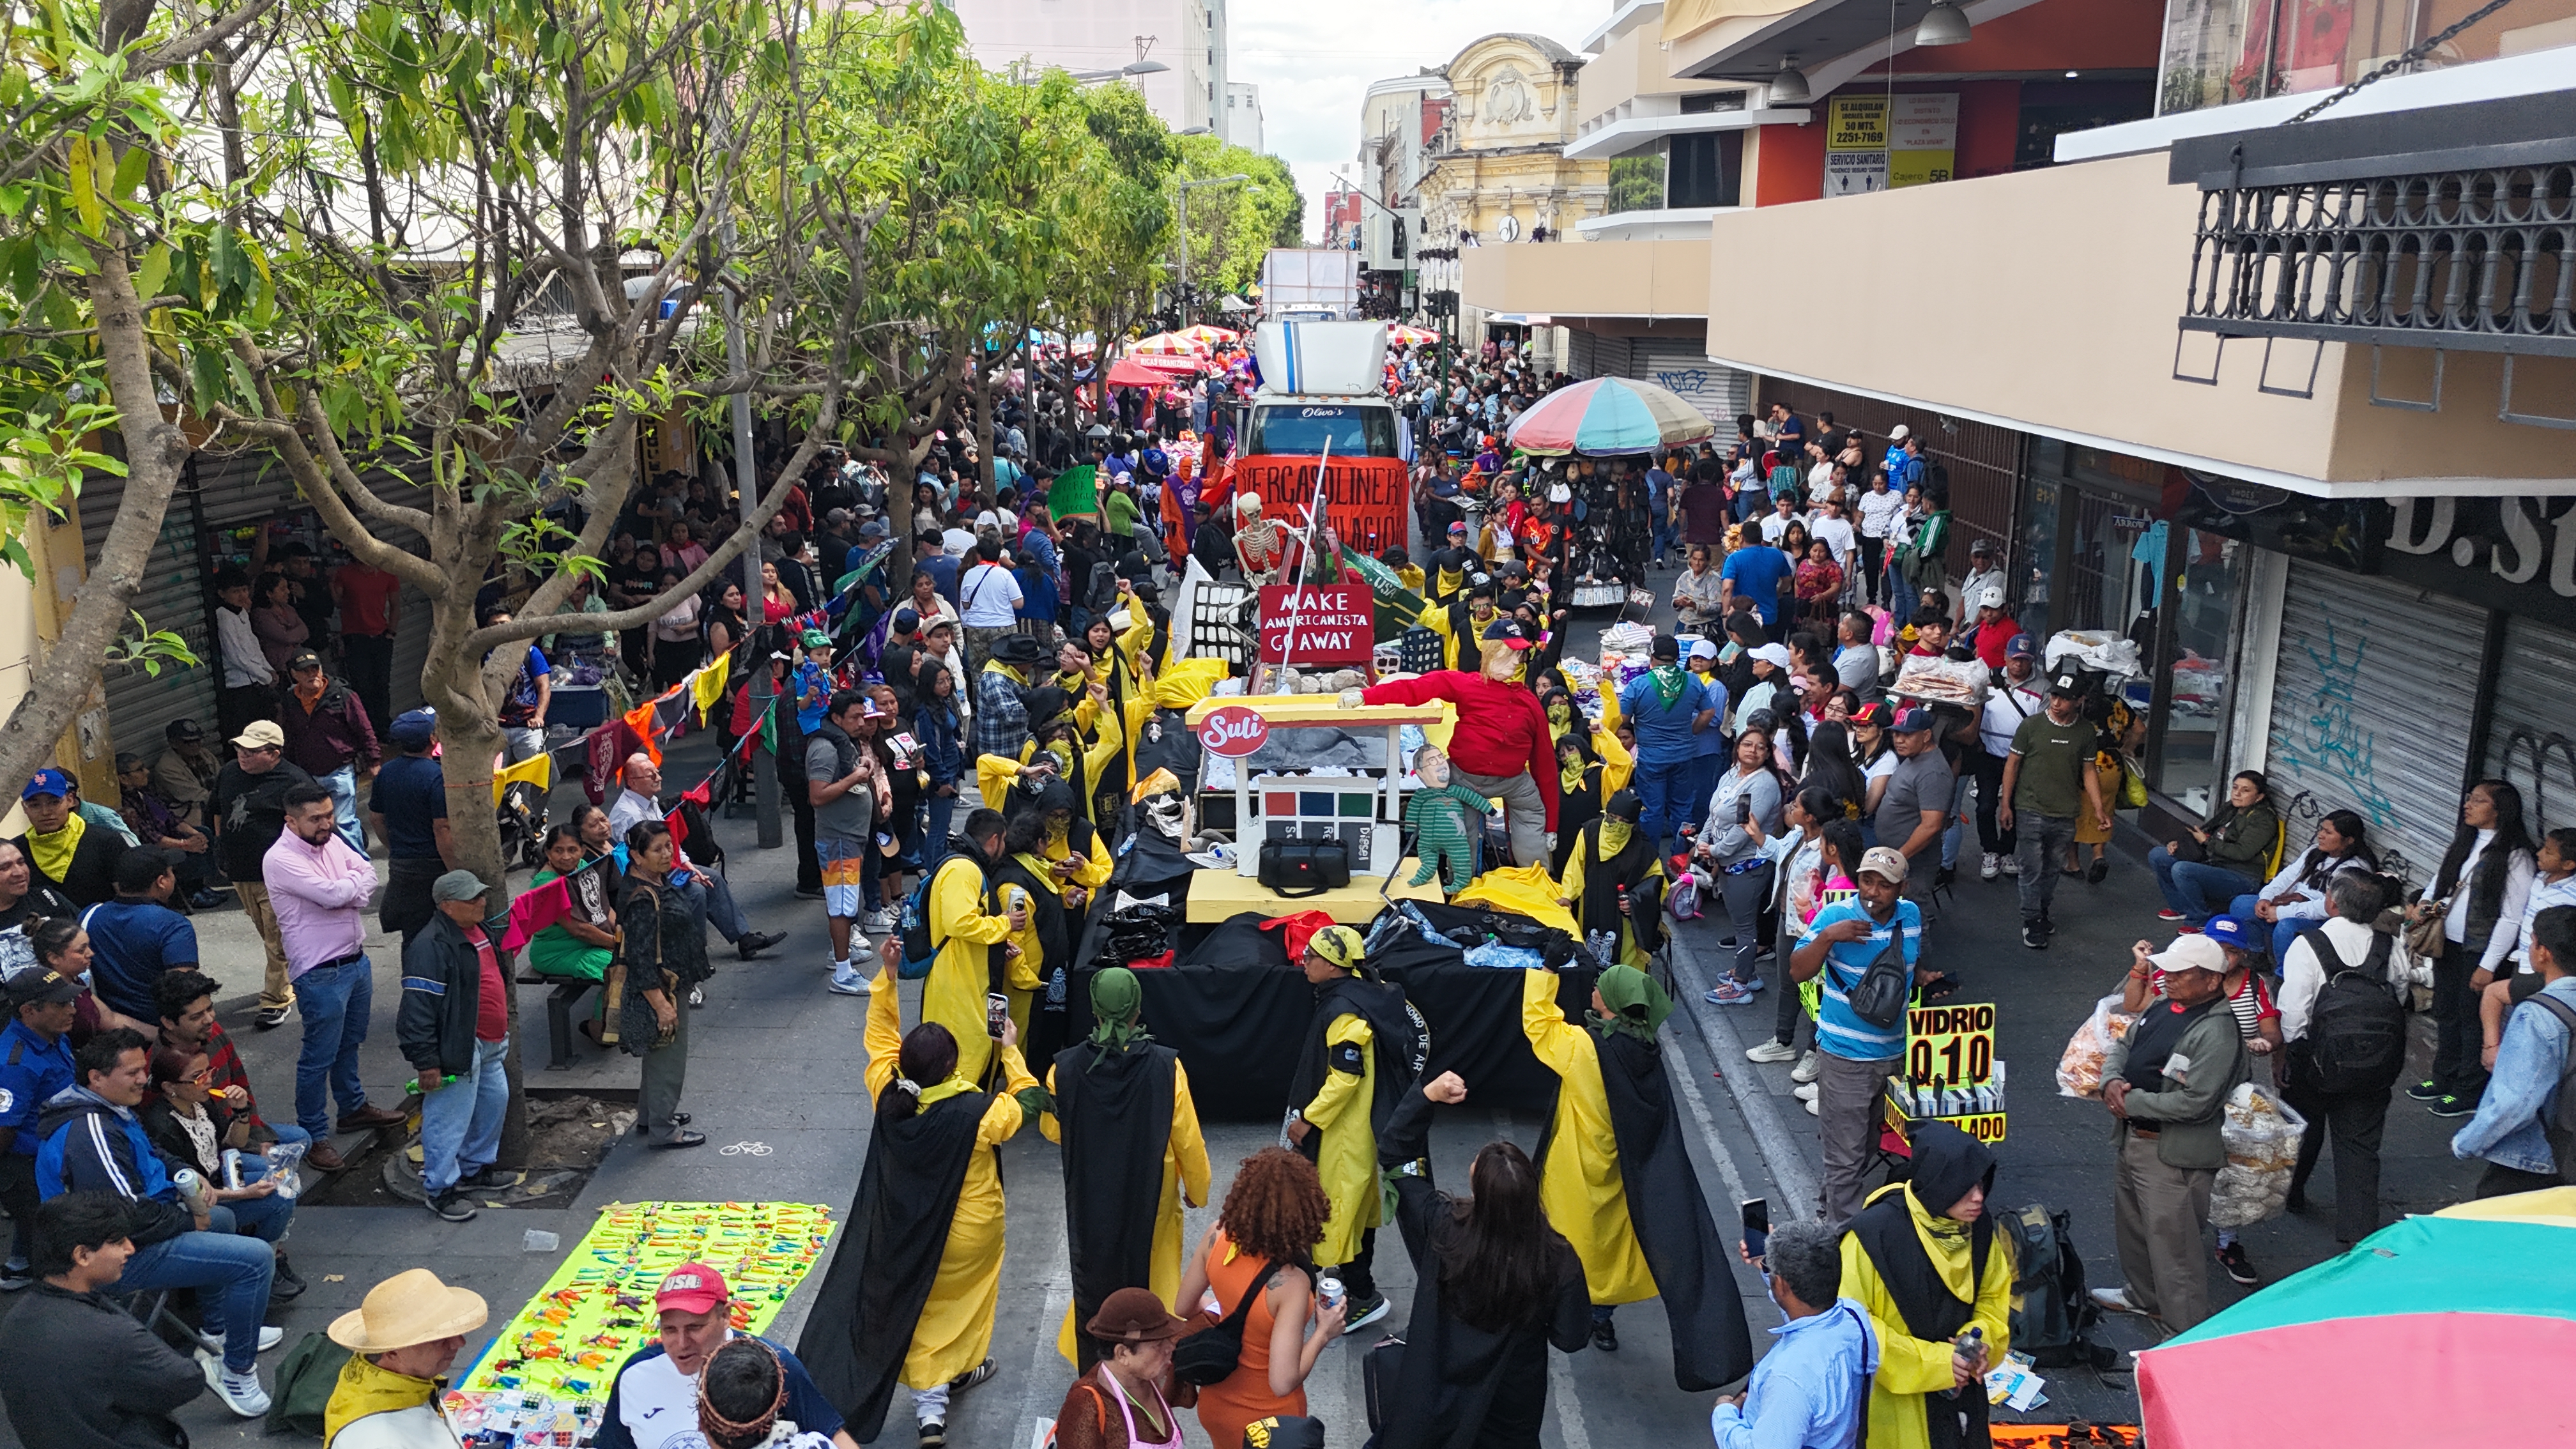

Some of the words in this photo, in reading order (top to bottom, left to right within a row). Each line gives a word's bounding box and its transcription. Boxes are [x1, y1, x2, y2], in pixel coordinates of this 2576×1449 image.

[1845, 122, 1856, 130] 50
[1857, 121, 1876, 130] MTS.
[1836, 132, 1883, 142] 2251-7169
[1830, 153, 1855, 165] SERVICIO
[1856, 153, 1885, 164] SANITARIO
[1893, 172, 1923, 181] Cajero
[1929, 169, 1949, 183] 5B
[1140, 358, 1158, 366] RICAS
[1159, 358, 1195, 368] GRANIZADAS
[2114, 518, 2145, 528] ARROW
[1280, 592, 1348, 611] MAKE
[1265, 614, 1368, 629] AMERICANISTA
[1271, 634, 1294, 652] GO
[1300, 631, 1354, 651] AWAY
[1203, 714, 1262, 747] Suli
[1358, 827, 1370, 861] Diesel
[1909, 1006, 1993, 1036] VIDRIO
[1418, 1034, 1429, 1050] DE
